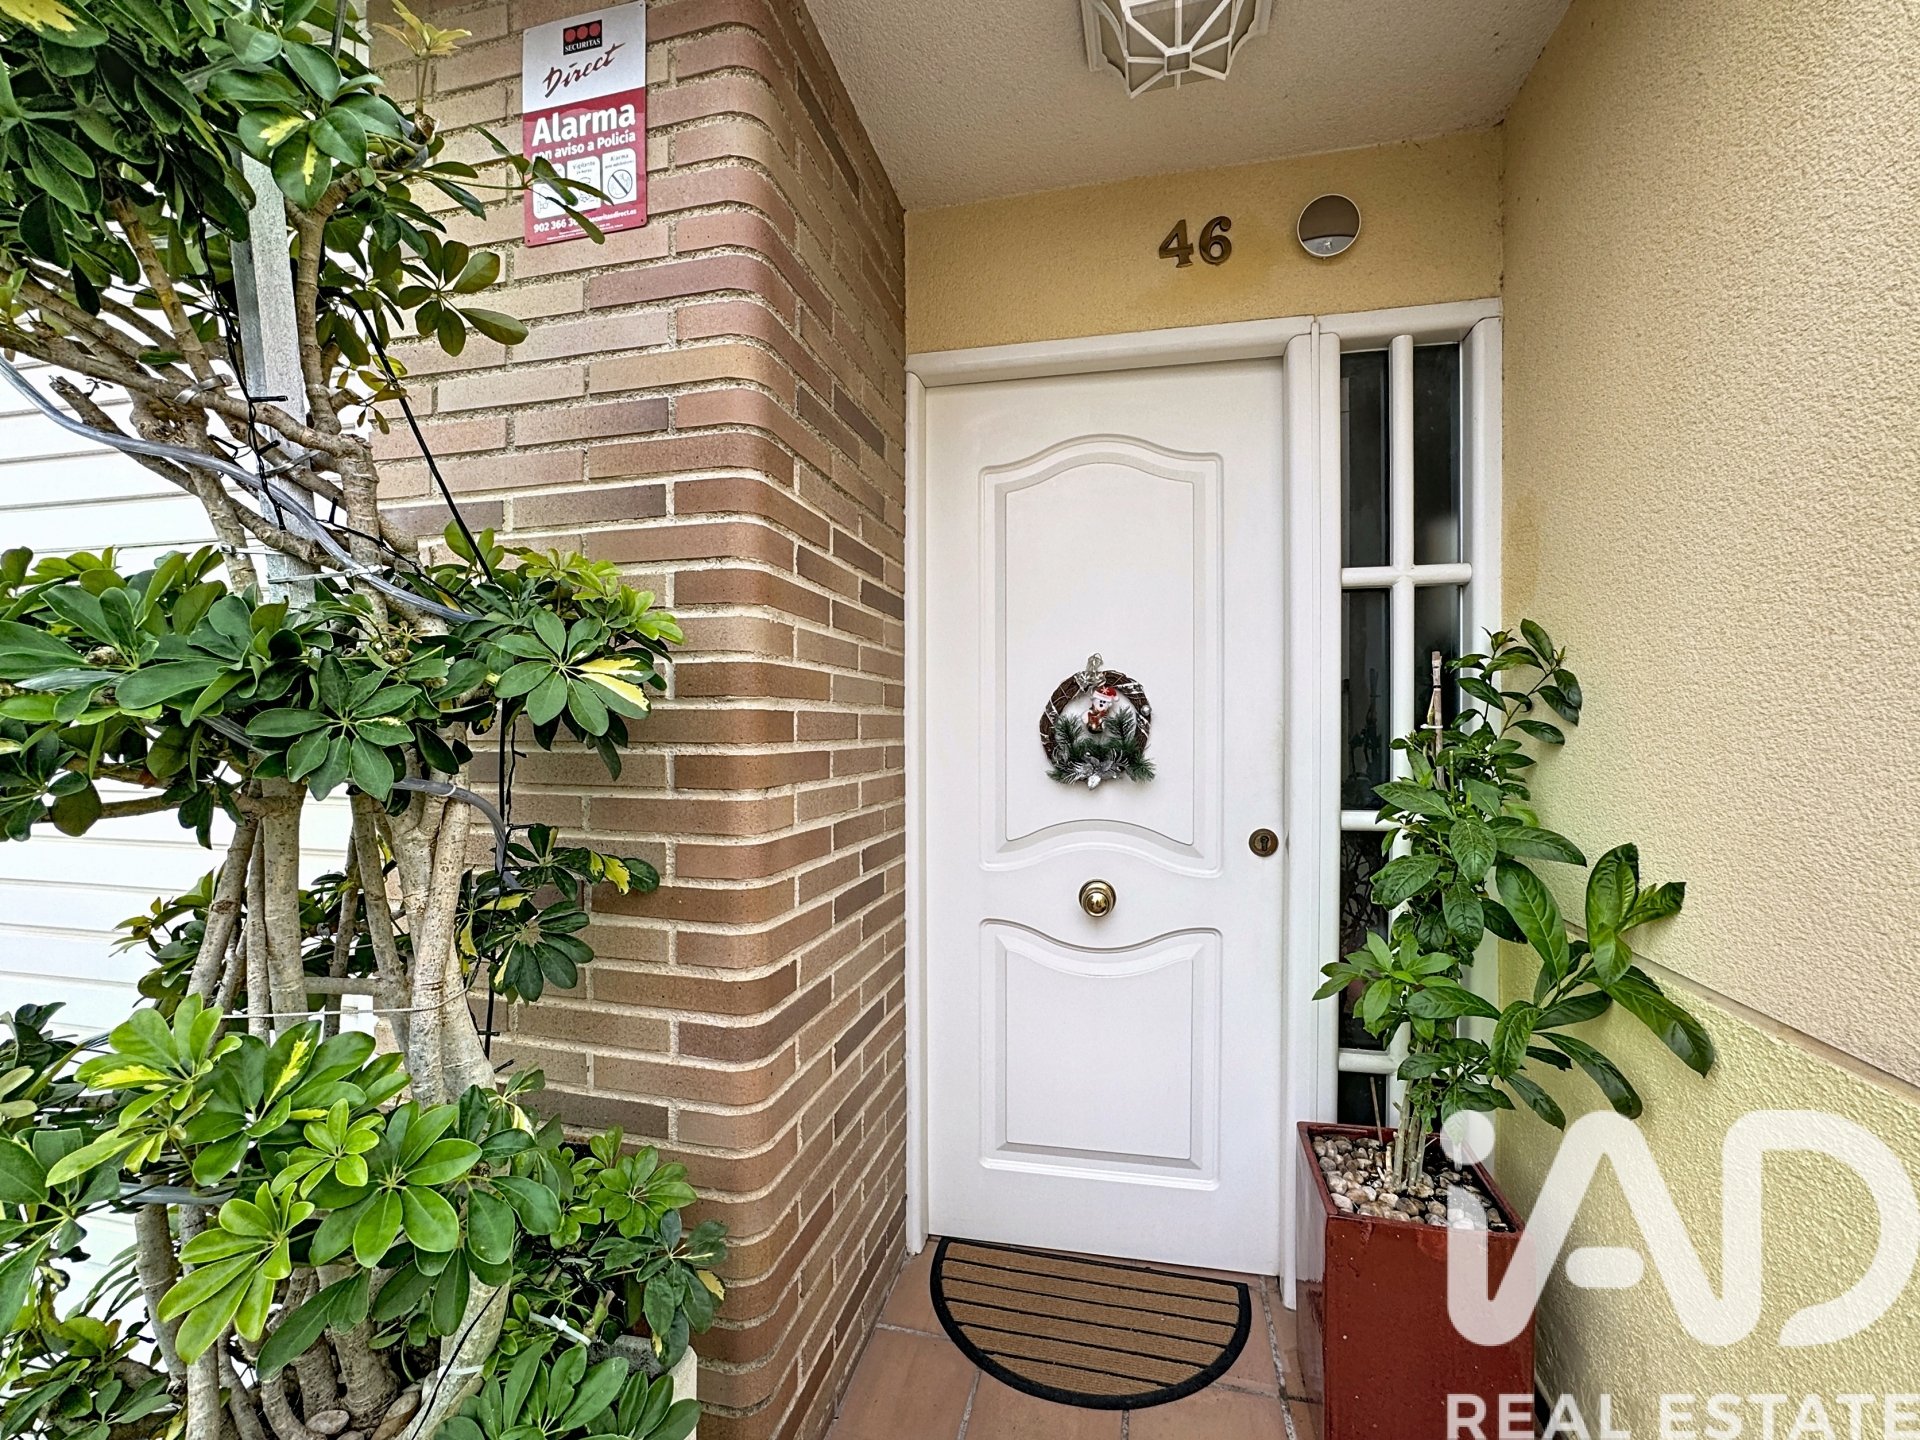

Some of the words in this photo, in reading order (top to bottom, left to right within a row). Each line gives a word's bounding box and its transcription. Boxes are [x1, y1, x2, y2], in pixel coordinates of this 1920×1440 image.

[564, 37, 601, 52] SECURITAS
[543, 42, 625, 98] Direct
[531, 103, 636, 147] Alarma
[554, 142, 585, 158] aviso
[587, 141, 595, 151] a
[597, 129, 636, 150] Policía
[533, 221, 550, 234] 902
[550, 218, 567, 230] 366
[1158, 215, 1232, 268] 46
